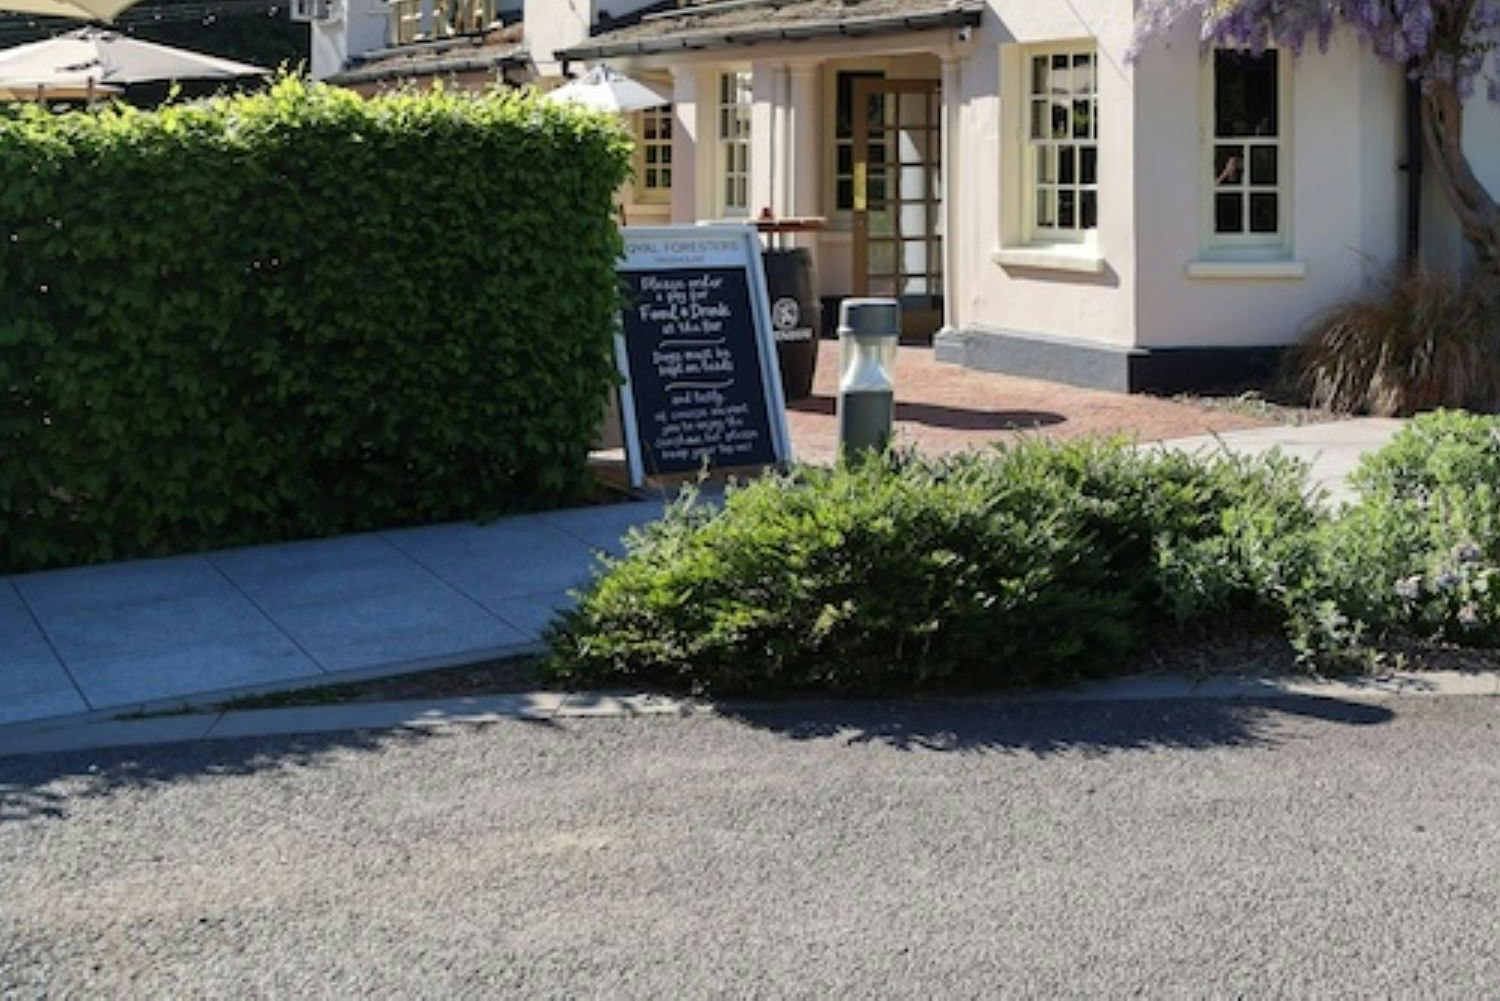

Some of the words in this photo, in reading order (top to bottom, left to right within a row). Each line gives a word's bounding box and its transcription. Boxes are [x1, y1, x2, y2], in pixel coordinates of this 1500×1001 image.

[625, 242, 659, 254] OYAL
[664, 240, 740, 253] FORESTERS
[640, 276, 686, 291] Please
[639, 303, 679, 320] Food
[690, 303, 731, 319] Drink
